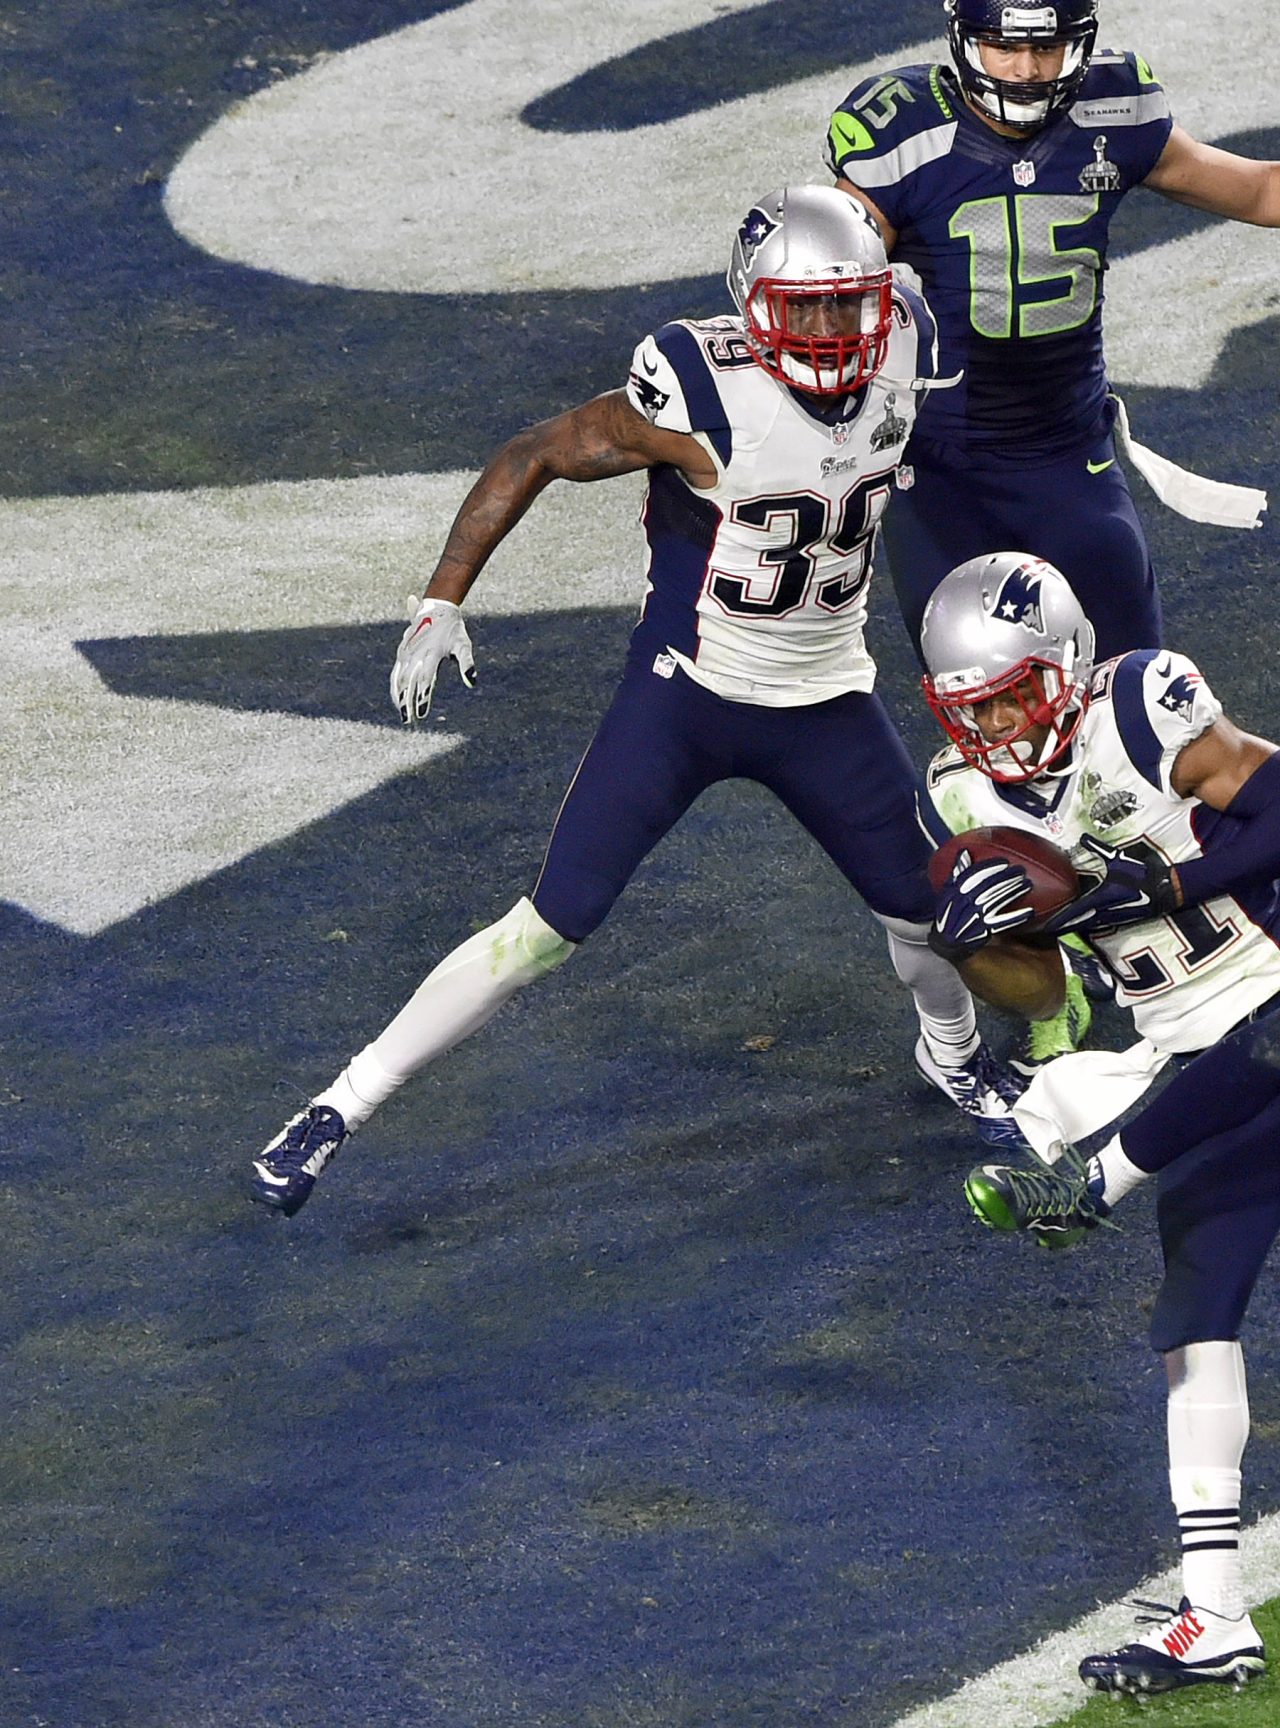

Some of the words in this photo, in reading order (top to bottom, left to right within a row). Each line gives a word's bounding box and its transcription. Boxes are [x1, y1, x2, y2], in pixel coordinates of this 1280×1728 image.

[853, 76, 916, 129] 15
[949, 194, 1101, 338] 15
[706, 464, 898, 621] 39
[1162, 1608, 1205, 1658] NIKE
